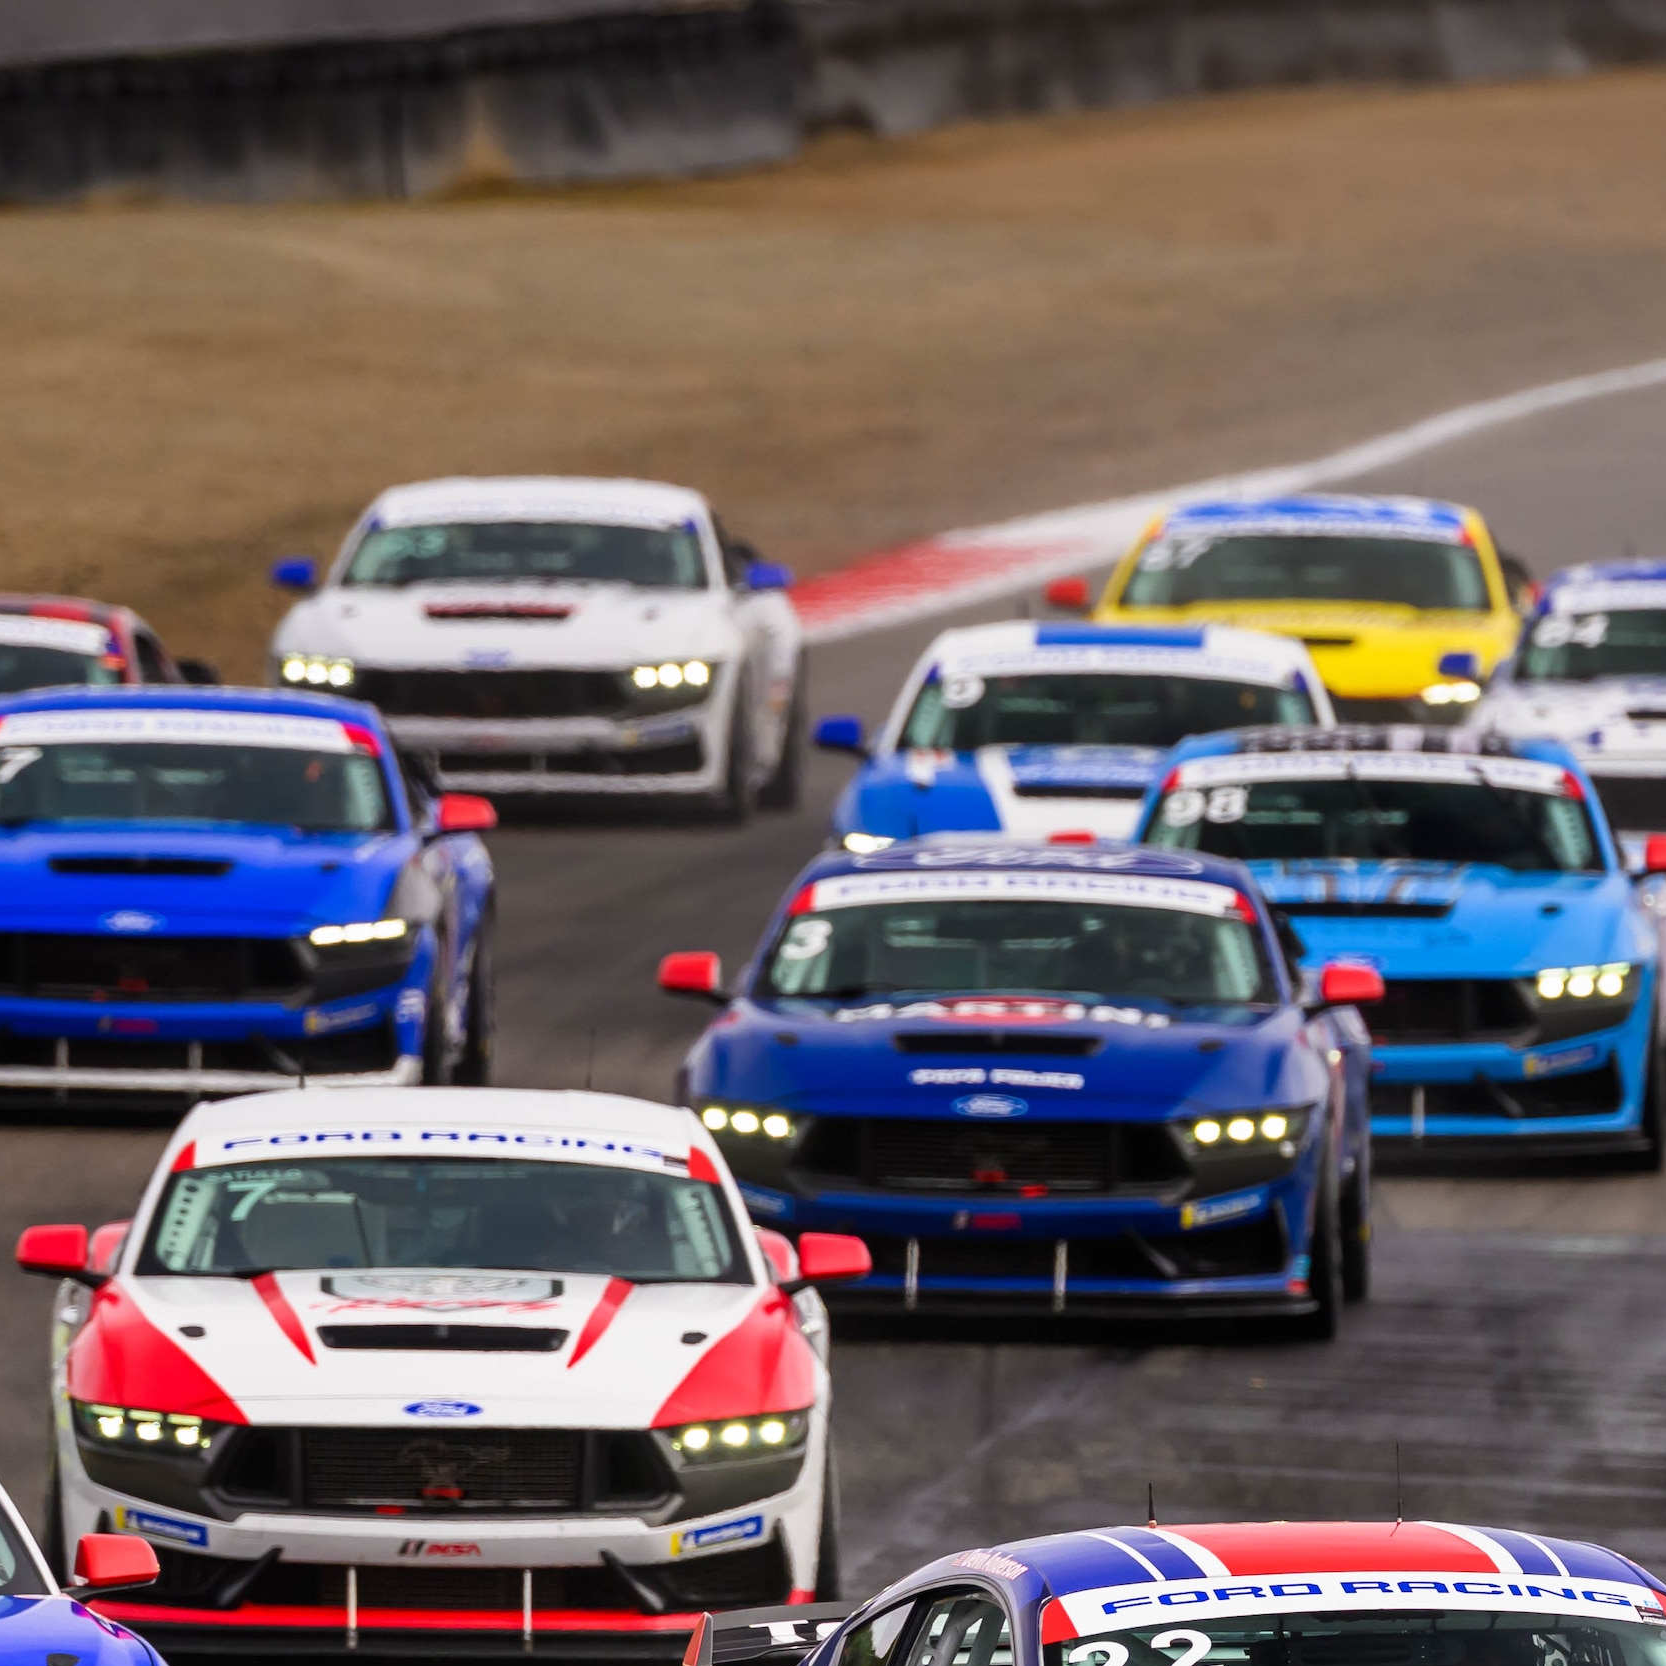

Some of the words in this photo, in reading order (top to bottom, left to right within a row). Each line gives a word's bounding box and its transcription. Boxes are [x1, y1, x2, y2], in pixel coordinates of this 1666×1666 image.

[780, 919, 832, 961] 3
[222, 1130, 402, 1149] FORD
[421, 1130, 664, 1157] RACING
[227, 1180, 277, 1222] 7
[1101, 1582, 1322, 1616] FORD
[1341, 1580, 1633, 1608] RACING
